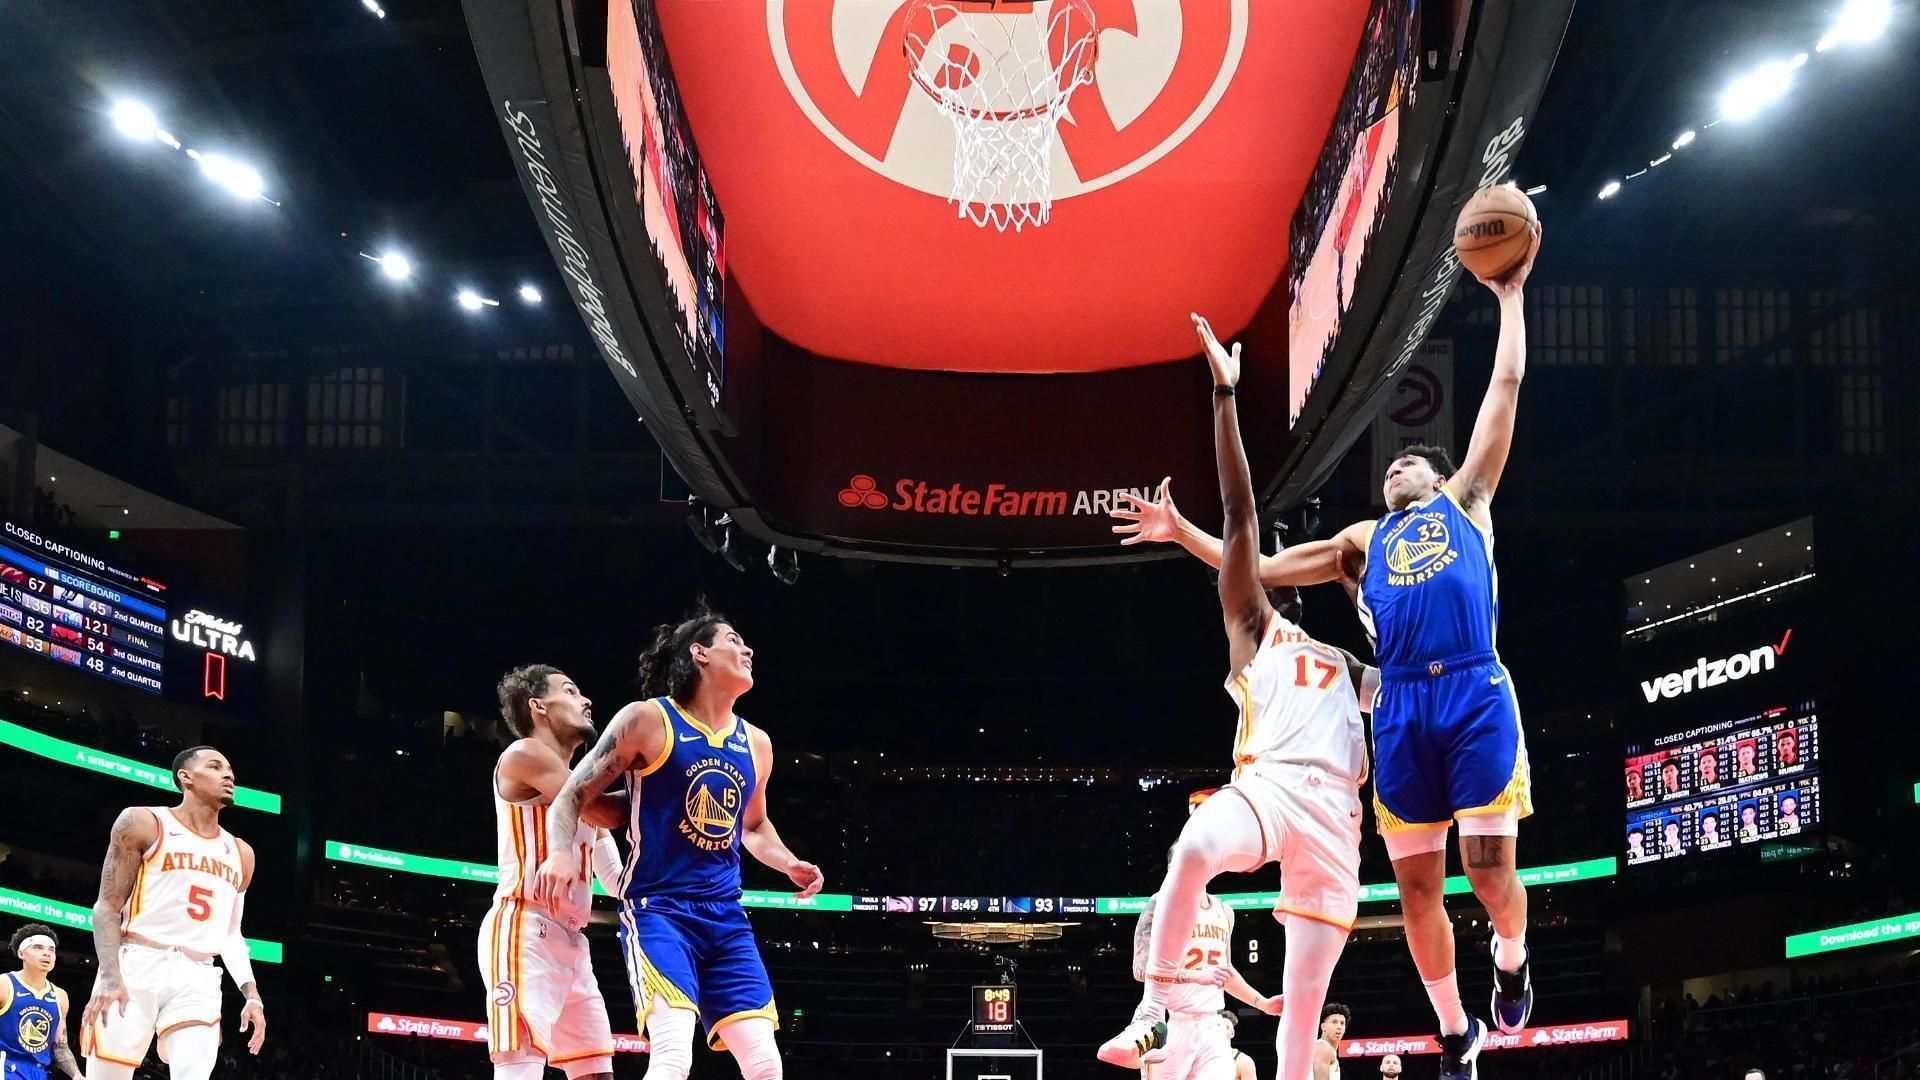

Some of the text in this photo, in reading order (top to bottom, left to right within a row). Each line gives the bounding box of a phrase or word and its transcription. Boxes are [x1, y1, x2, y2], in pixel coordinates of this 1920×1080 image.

[1417, 523, 1443, 542] 32
[5, 522, 43, 546] CLOSED
[45, 540, 105, 571] CAPTIONING
[1388, 549, 1458, 586] WARRIORS
[29, 577, 46, 593] 67
[61, 573, 121, 603] SCOREBOARD
[26, 594, 49, 614] 136
[89, 602, 106, 616] 45
[27, 617, 44, 633] 82
[85, 617, 108, 636] 121
[114, 611, 163, 635] 2nd QUARTER
[26, 636, 43, 652] 53
[87, 639, 104, 654] 54
[128, 634, 149, 648] FINAL
[172, 619, 256, 662] ULTRA
[86, 657, 104, 672] 48
[113, 649, 161, 672] 3rd QUARTER
[112, 667, 162, 689] 2nd QUARTER
[1295, 655, 1338, 690] 17
[1641, 645, 1774, 703] verizon
[1654, 732, 1684, 746] CLOSED
[1686, 720, 1733, 738] CAPTIONING
[76, 751, 85, 762] A
[134, 768, 156, 783] way
[158, 774, 170, 785] to
[686, 758, 746, 788] GOLDEN STATE
[723, 787, 736, 808] 15
[161, 852, 239, 891] ATLANTA
[187, 885, 213, 921] 5
[918, 897, 937, 911] 97
[951, 898, 978, 911] 8:49
[1035, 898, 1053, 912] 93
[45, 905, 62, 918] the
[65, 911, 86, 925] app
[1820, 926, 1879, 946] Download
[1882, 923, 1901, 935] the
[984, 989, 1010, 1002] 8:49
[989, 1001, 1007, 1022] 18
[35, 1020, 48, 1030] 25
